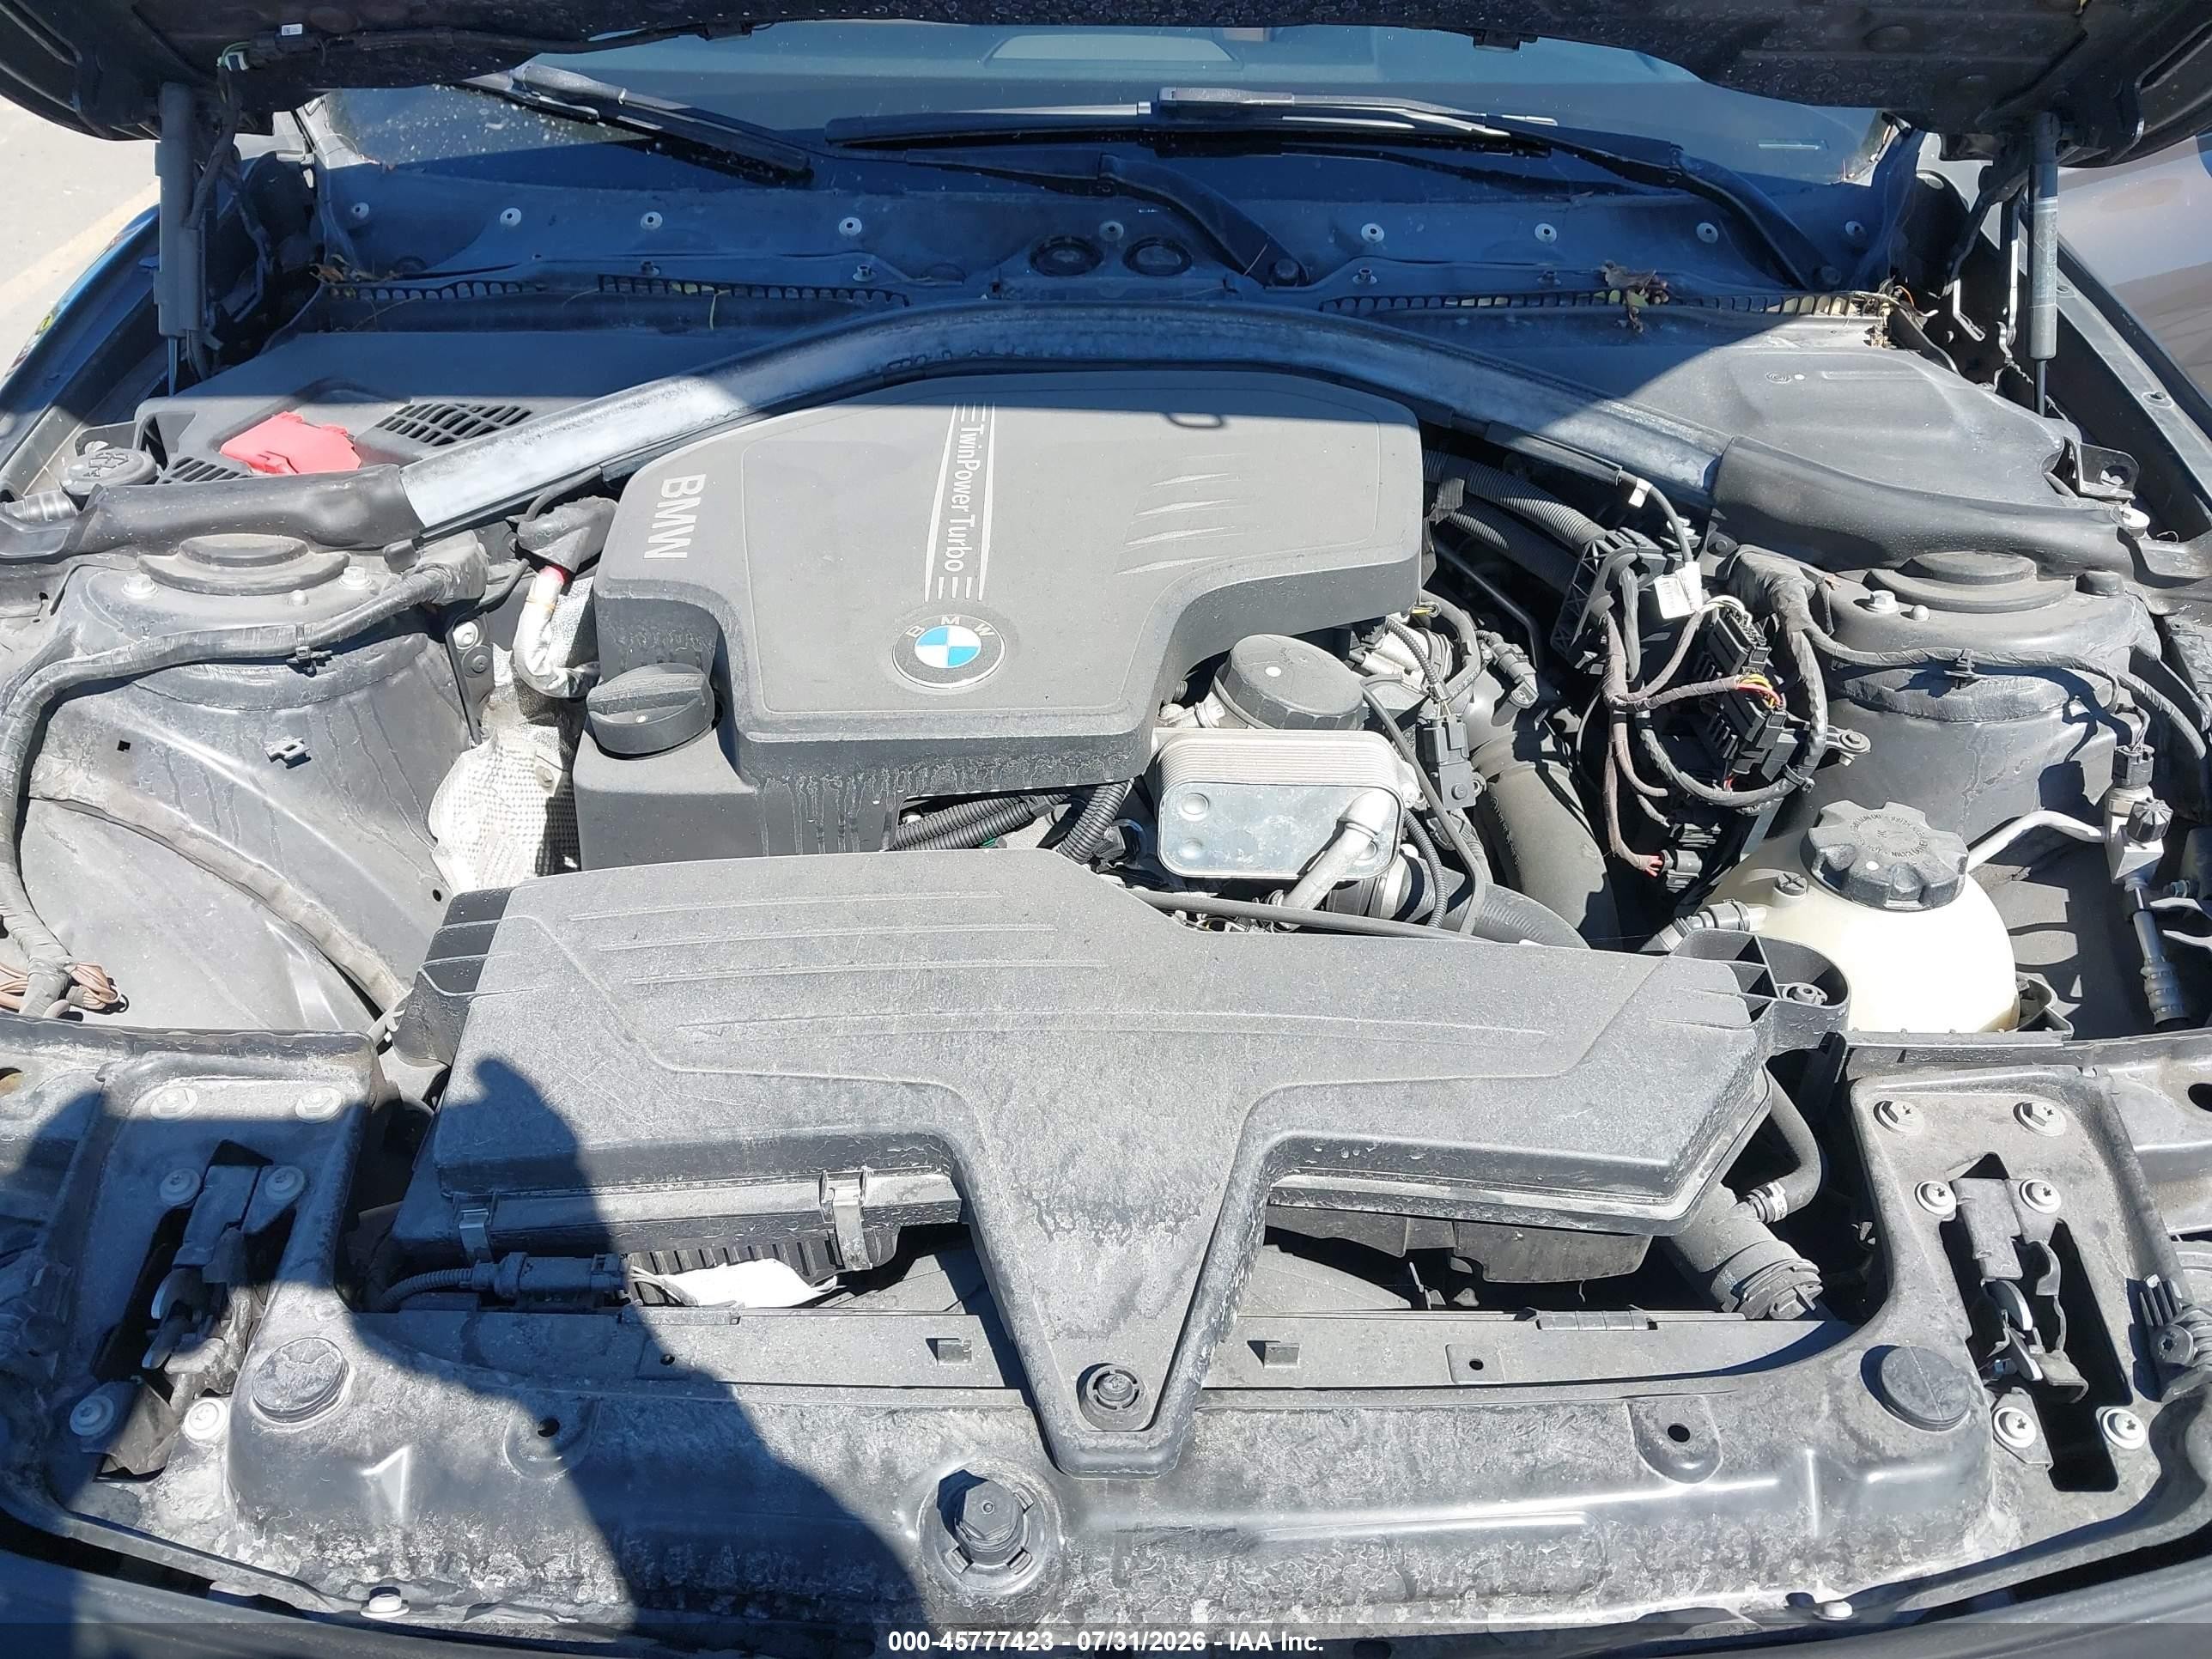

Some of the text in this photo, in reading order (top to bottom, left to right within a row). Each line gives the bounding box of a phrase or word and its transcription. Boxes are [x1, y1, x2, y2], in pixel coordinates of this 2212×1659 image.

[642, 473, 708, 560] BMW
[944, 423, 984, 572] TwinPower Turbo
[905, 615, 997, 639] BMW
